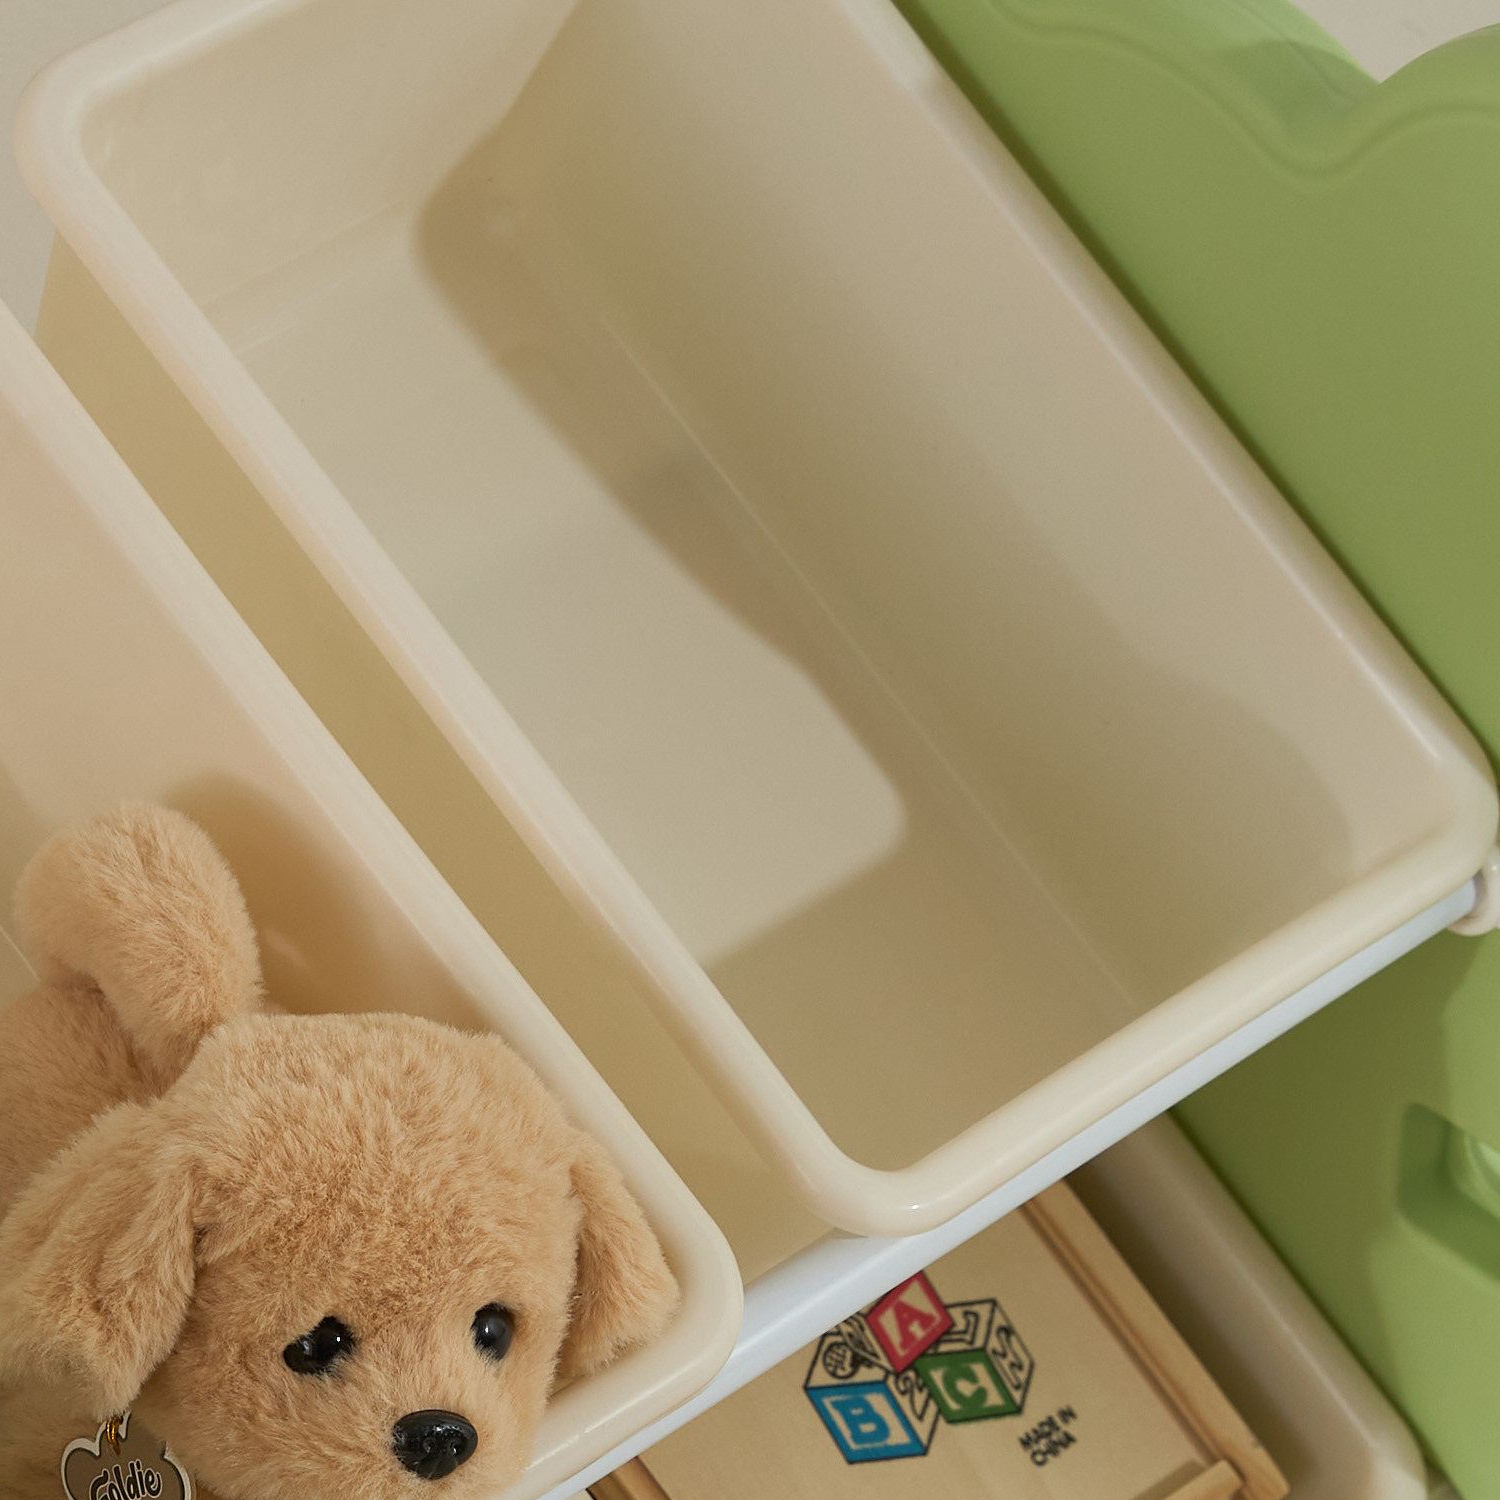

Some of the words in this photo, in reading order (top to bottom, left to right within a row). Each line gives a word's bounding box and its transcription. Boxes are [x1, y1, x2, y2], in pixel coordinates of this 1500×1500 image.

[1019, 1415, 1061, 1453] MADE
[1057, 1404, 1078, 1426] IN
[1030, 1430, 1077, 1467] CHINA
